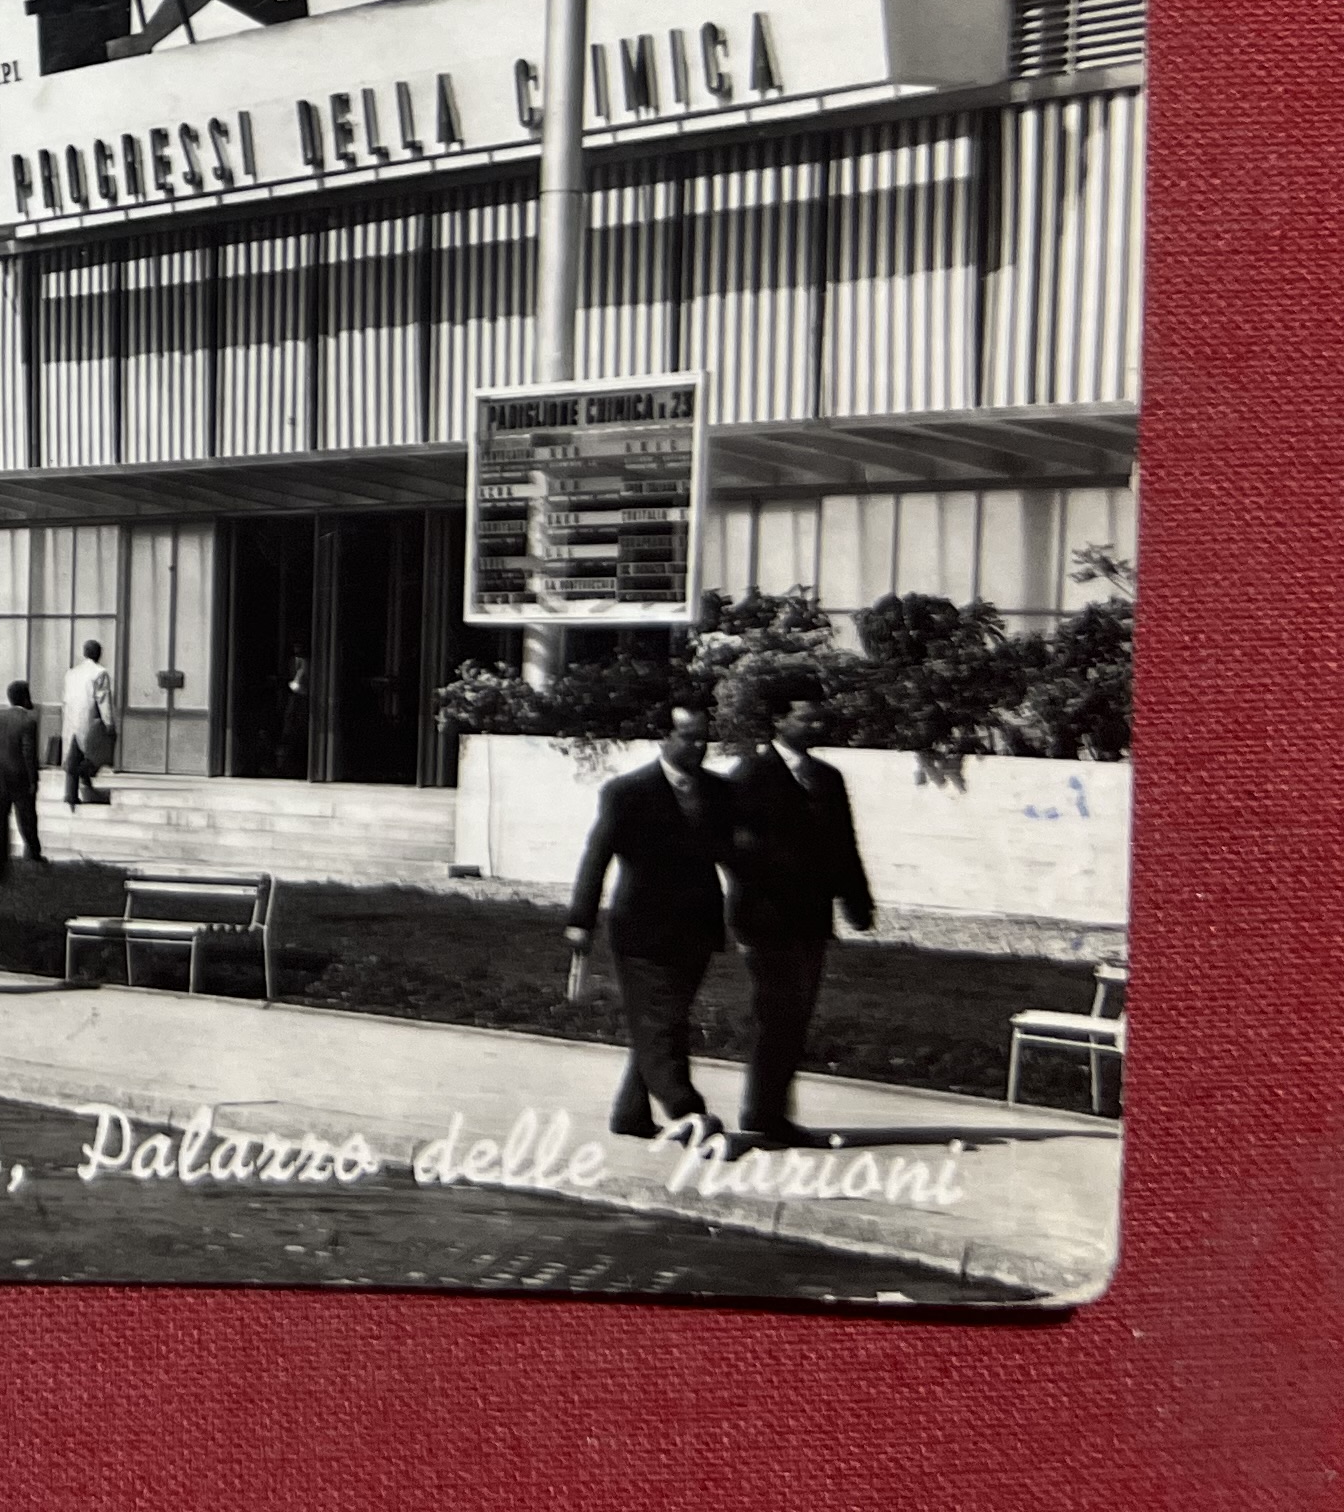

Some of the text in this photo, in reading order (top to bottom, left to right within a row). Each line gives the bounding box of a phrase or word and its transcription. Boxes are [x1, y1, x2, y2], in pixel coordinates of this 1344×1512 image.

[12, 110, 257, 218] PROGRESSI
[296, 73, 465, 171] DELLA
[514, 11, 783, 131] CIMICA
